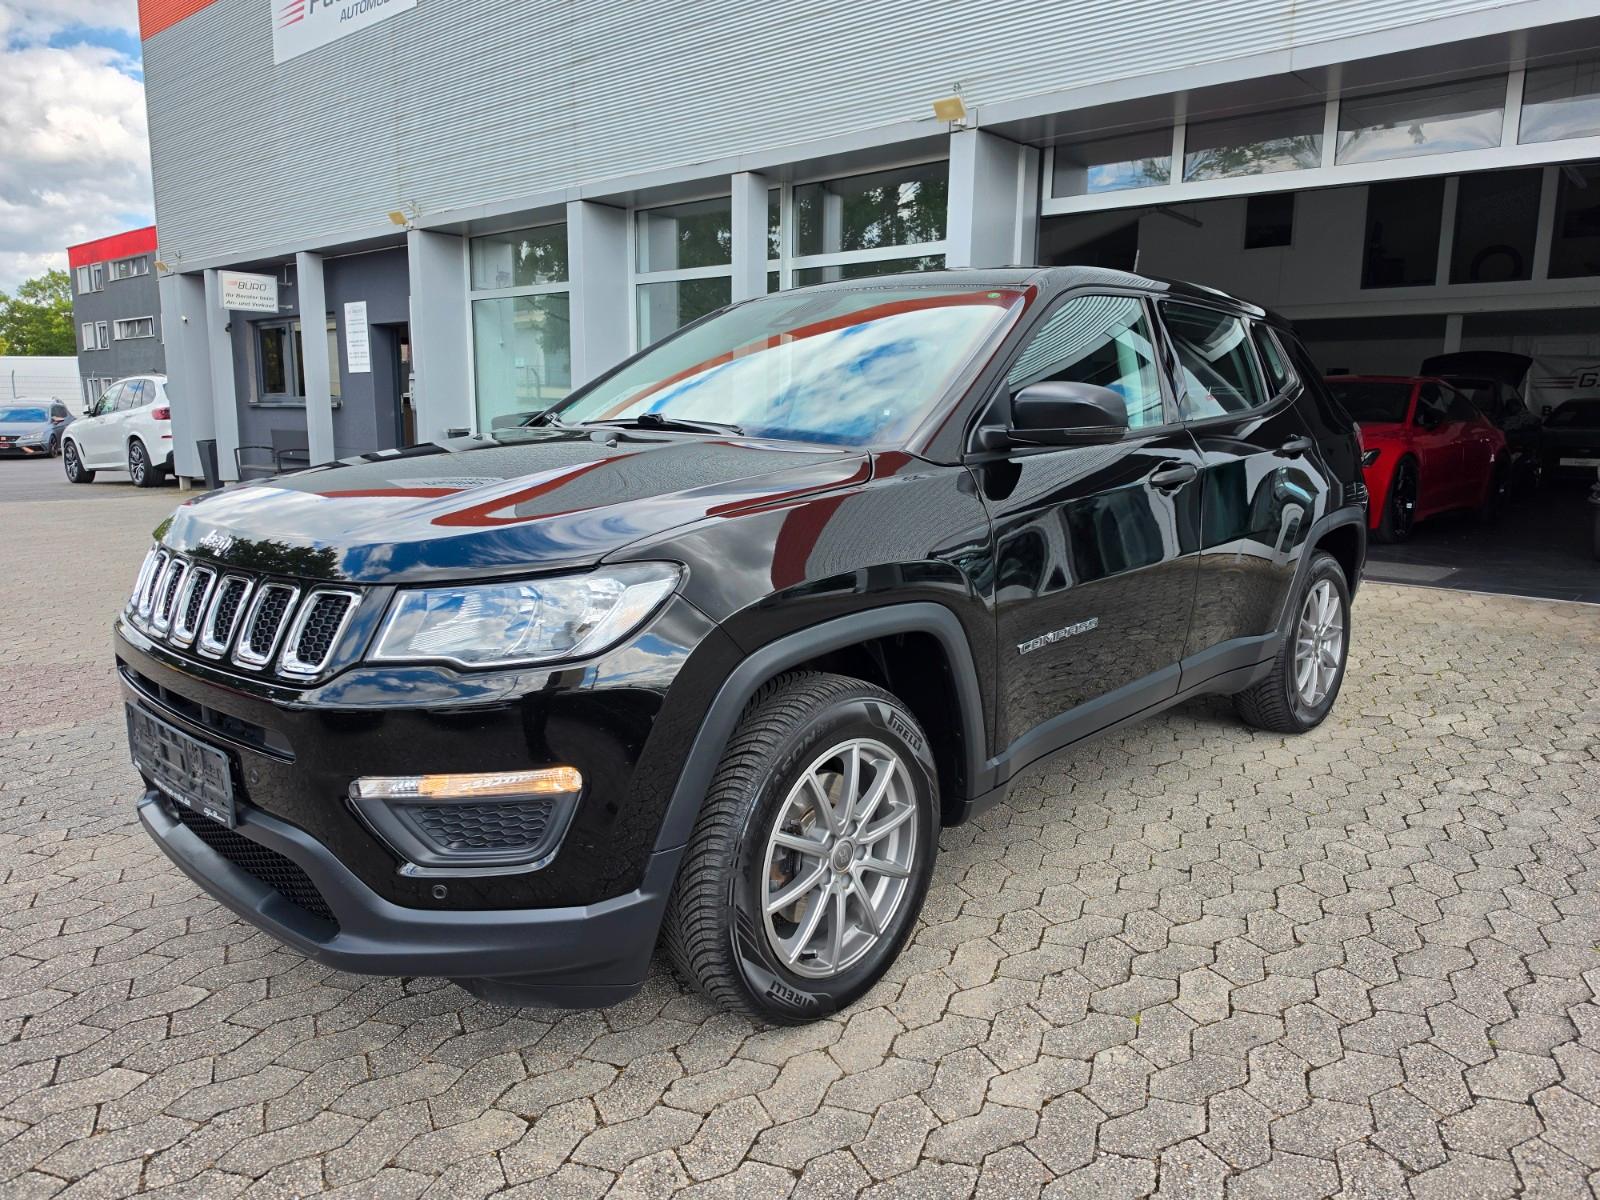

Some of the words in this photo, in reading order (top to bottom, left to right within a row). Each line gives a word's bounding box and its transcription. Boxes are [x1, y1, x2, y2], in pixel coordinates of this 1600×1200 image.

[340, 0, 389, 23] AUTOM
[1016, 617, 1099, 655] COMPASS
[887, 709, 923, 752] PIRELLI
